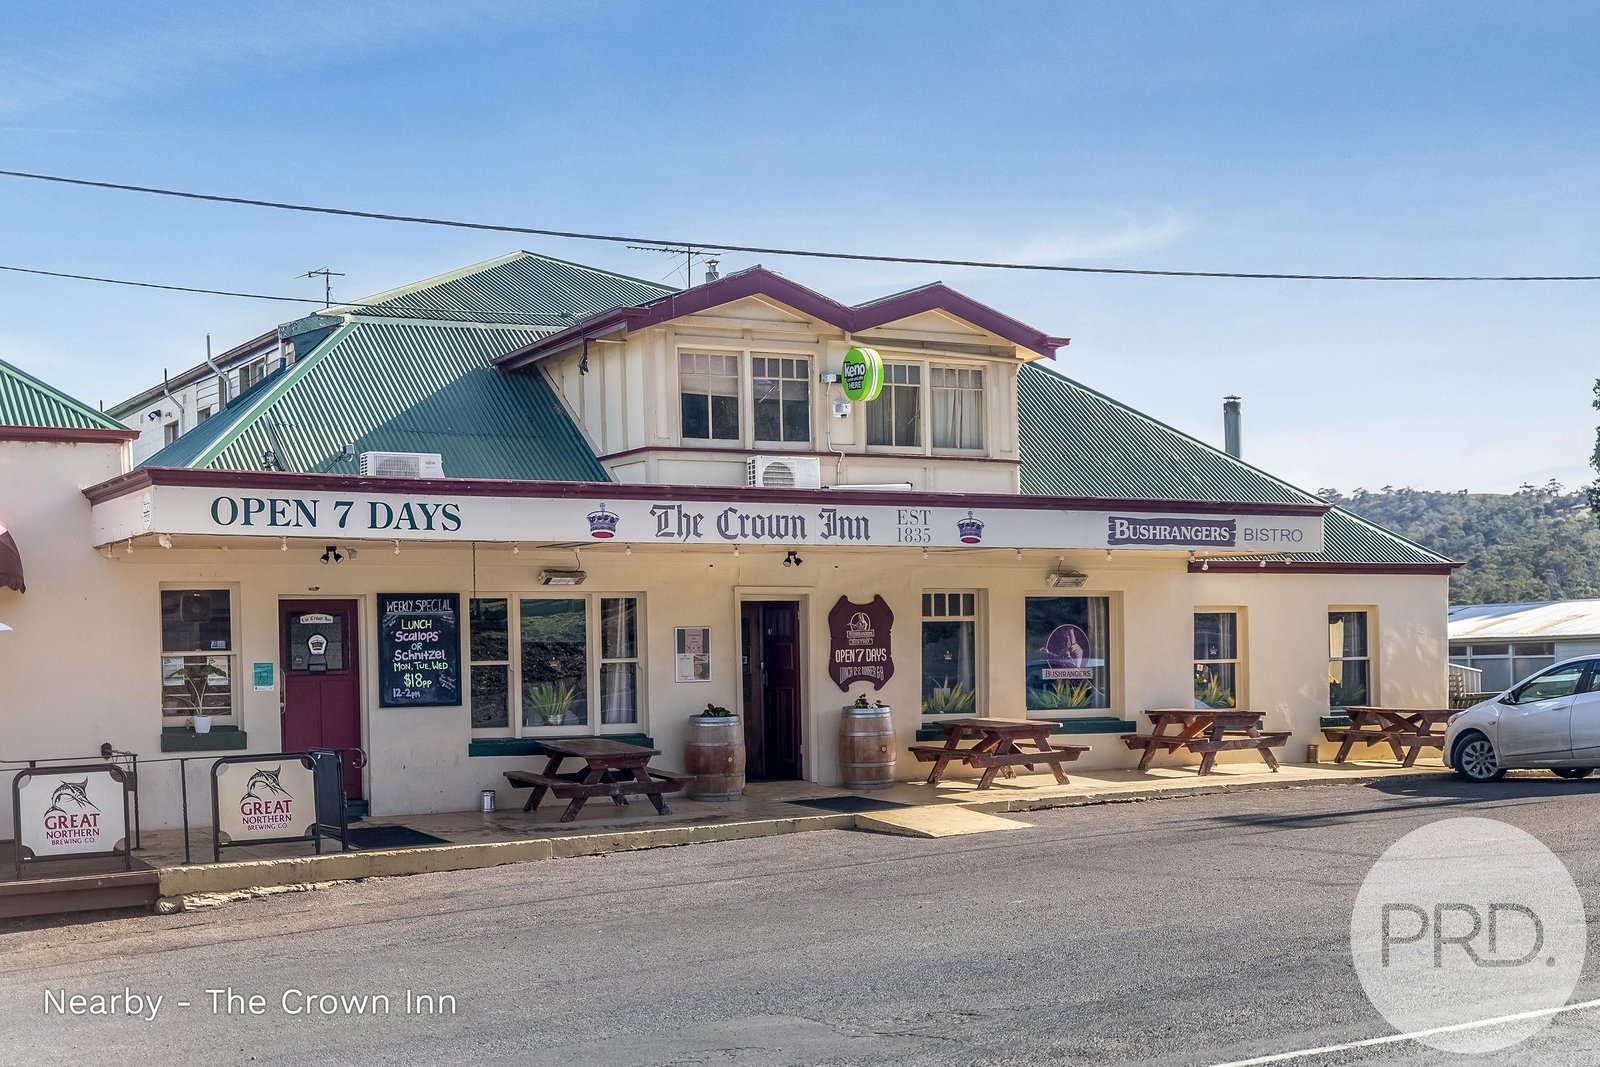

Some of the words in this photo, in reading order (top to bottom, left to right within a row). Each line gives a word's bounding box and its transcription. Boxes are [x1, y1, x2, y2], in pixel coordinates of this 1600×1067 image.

[844, 362, 865, 377] keno
[210, 496, 319, 528] OPEN
[333, 501, 354, 528] 7
[367, 501, 462, 532] DAYS
[897, 509, 931, 525] EST
[649, 504, 705, 542] The
[716, 507, 808, 541] Crown
[818, 508, 871, 541] Inn
[897, 527, 931, 543] 1835
[1244, 528, 1303, 543] BISTRO
[386, 600, 413, 612] WEEKLY
[415, 599, 452, 612] SPECIAL
[401, 619, 432, 629] LUNCH
[411, 642, 422, 650] OR
[835, 649, 855, 662] OPEN
[855, 649, 865, 662] 7
[865, 648, 887, 661] DAYS
[431, 660, 449, 670] WED
[240, 799, 293, 816] GREAT
[44, 813, 100, 830] GREAT
[242, 814, 292, 825] NORTHERN
[46, 828, 100, 839] NORTHERN
[51, 838, 82, 846] BREWING
